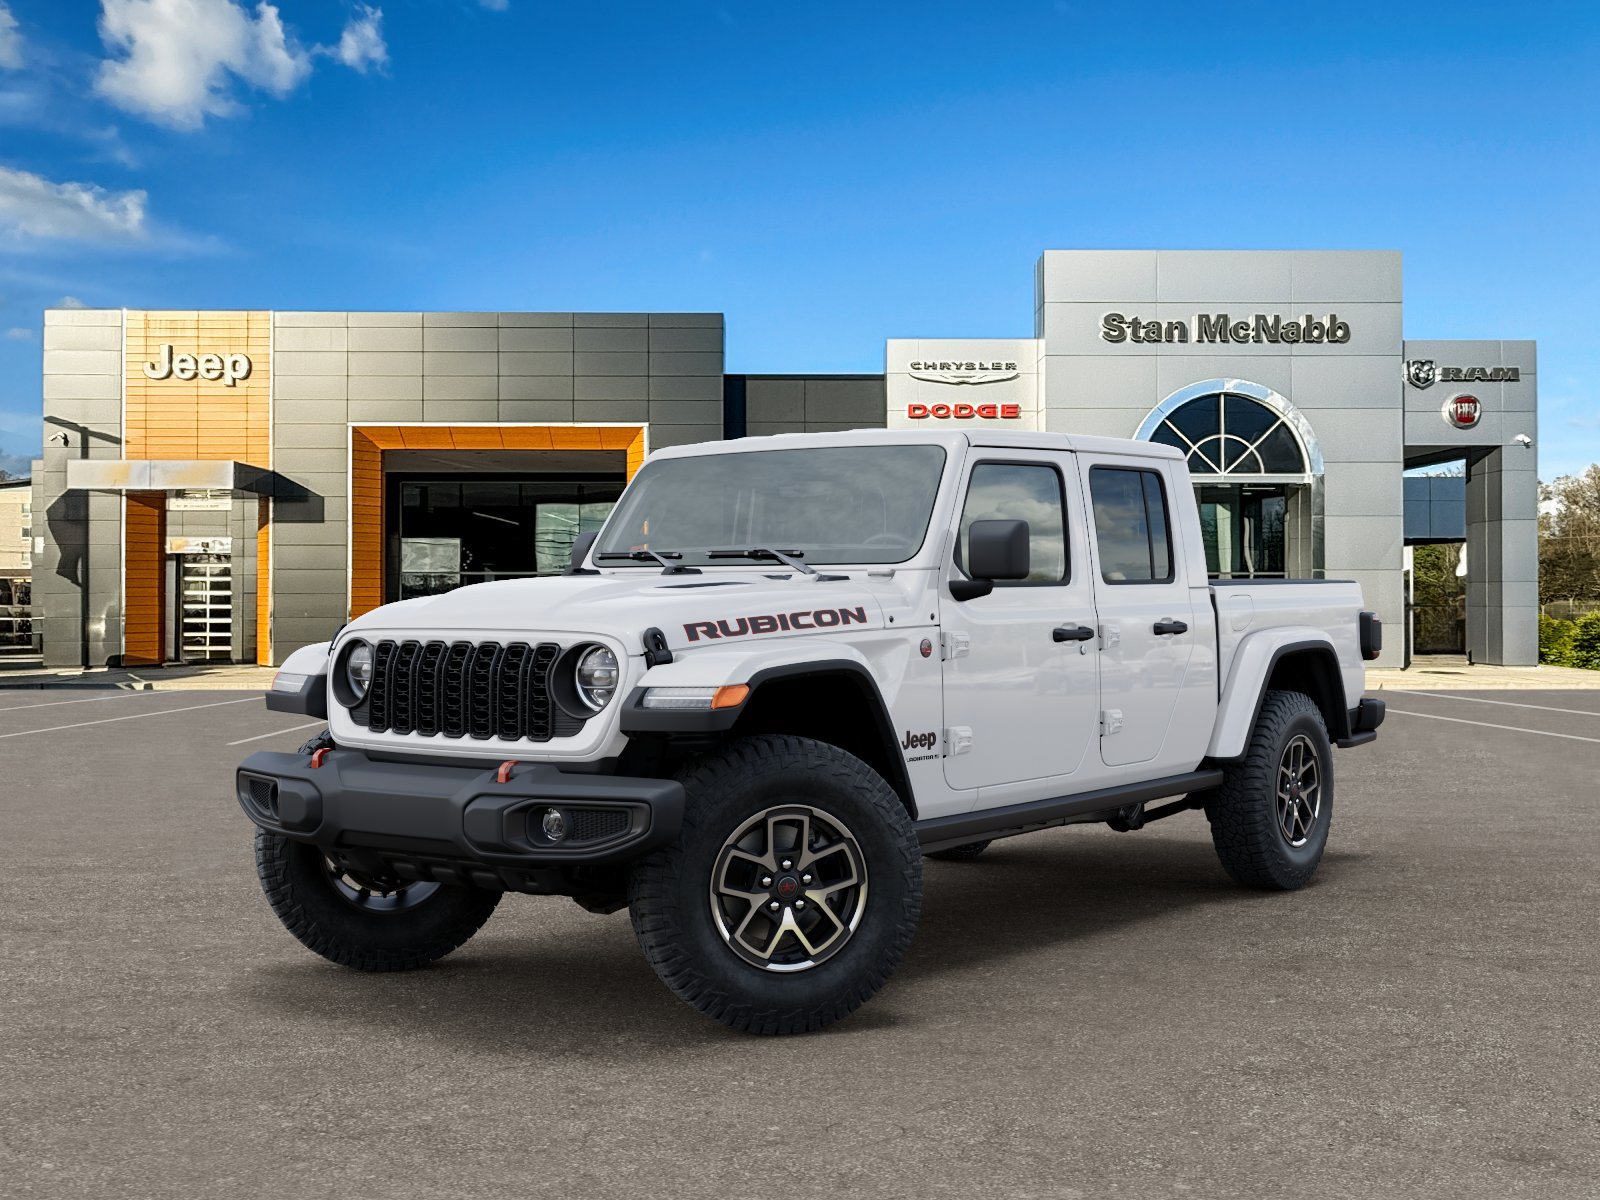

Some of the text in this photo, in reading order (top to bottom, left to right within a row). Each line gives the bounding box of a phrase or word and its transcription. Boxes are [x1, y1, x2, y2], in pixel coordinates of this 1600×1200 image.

[1101, 313, 1351, 343] Stan McNabb
[143, 344, 253, 387] Jeep
[910, 360, 1018, 371] CHRYSLER
[1441, 367, 1520, 382] RAM
[907, 403, 1021, 419] DODGE
[683, 606, 867, 642] RUBICON
[901, 730, 937, 750] Jeep
